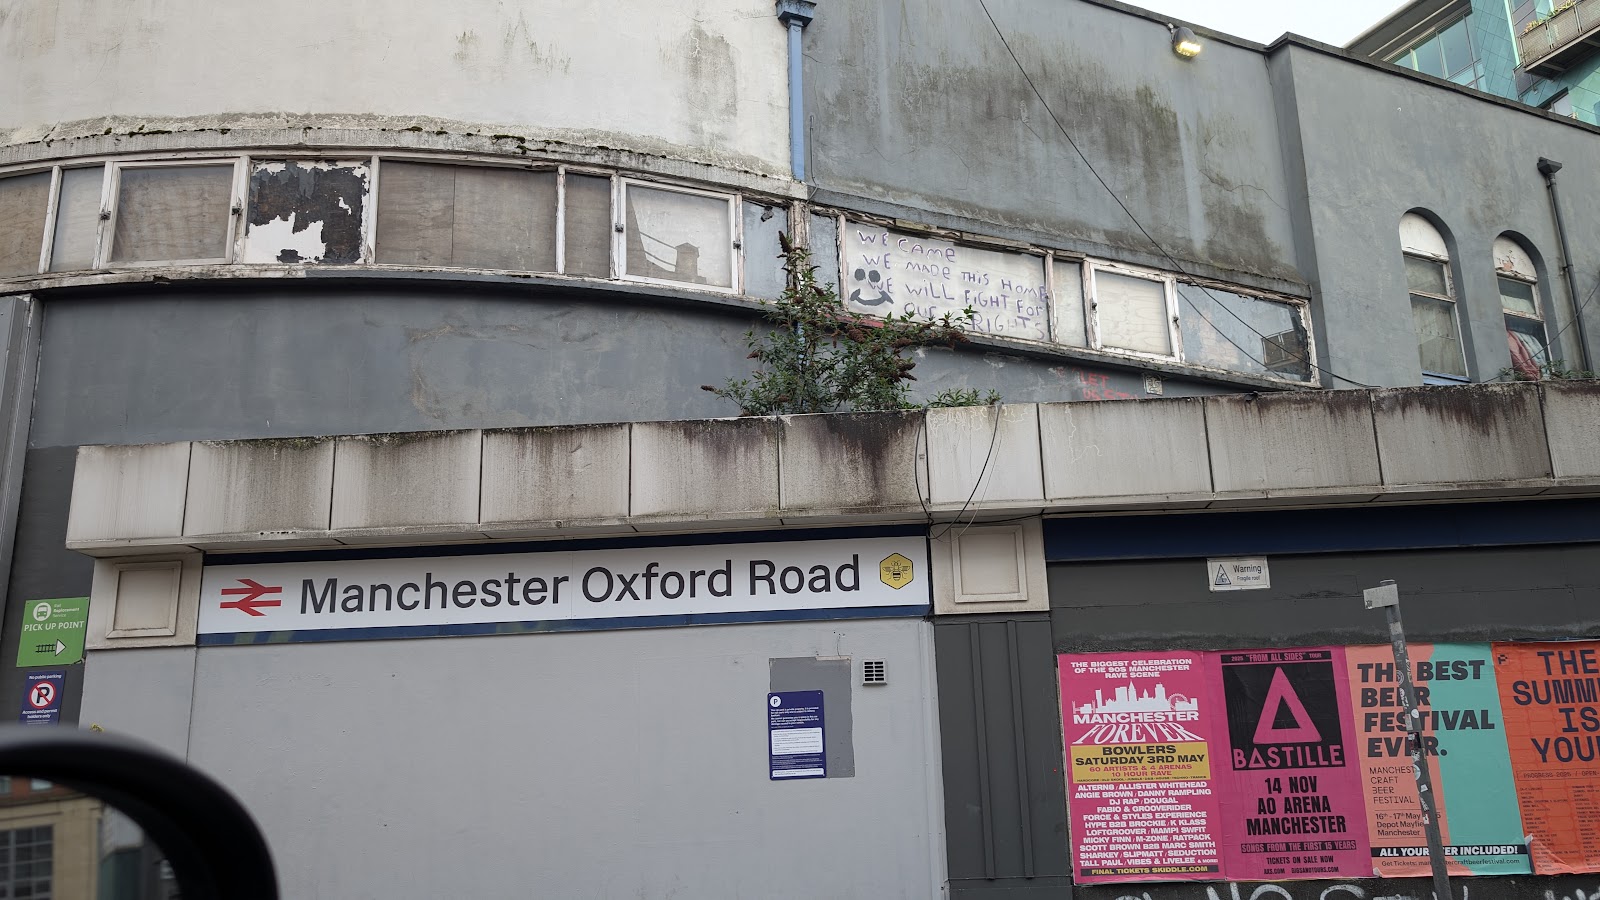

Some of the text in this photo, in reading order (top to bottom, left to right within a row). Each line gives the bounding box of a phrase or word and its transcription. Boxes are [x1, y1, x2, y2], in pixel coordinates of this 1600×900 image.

[857, 230, 889, 246] WE
[863, 252, 890, 270] WE
[868, 277, 893, 294] WE
[971, 313, 1045, 340] RIGHTS
[1233, 564, 1262, 574] Warning
[300, 553, 860, 614] Manchester Oxford Road
[45, 622, 56, 630] UP
[58, 620, 84, 629] POINT
[1271, 653, 1282, 661] ALL
[1537, 649, 1600, 676] THE
[1416, 660, 1485, 681] BEST
[1512, 677, 1600, 706] SUMM
[1073, 711, 1199, 724] MANCHESTER
[1558, 706, 1600, 733] IS
[1072, 722, 1206, 744] FOREVER
[1102, 745, 1176, 755] BOWLERS
[1531, 735, 1600, 763] YOU
[1075, 754, 1205, 766] SATURDAY 3RD MAY
[1369, 765, 1415, 775] MANCHEST
[1159, 781, 1207, 789] WHITEHEAD
[1264, 776, 1317, 794] 14 NOV
[1370, 776, 1398, 784] CRAFT
[1168, 788, 1211, 796] RAMPLING
[1372, 786, 1395, 794] BEER
[1257, 795, 1331, 815] AO ARENA
[1373, 796, 1415, 804] FESTIVAL
[1132, 804, 1192, 812] GROOVERIDER
[1122, 812, 1153, 820] STYLES
[1155, 811, 1207, 819] EXPERIENCE
[1405, 812, 1421, 820] May
[1246, 815, 1347, 836] MANCHESTER
[1376, 821, 1399, 829] Depot
[1080, 844, 1107, 852] SCOTT
[1109, 843, 1140, 851] BROWN
[1241, 840, 1356, 852] SONGS FROM THE FIRST 15 YEARS
[1380, 845, 1518, 856] ALL YOUR INCLUDED!
[1266, 856, 1290, 865] TICKETS
[1292, 856, 1301, 864] ON
[1319, 855, 1334, 863] NOW
